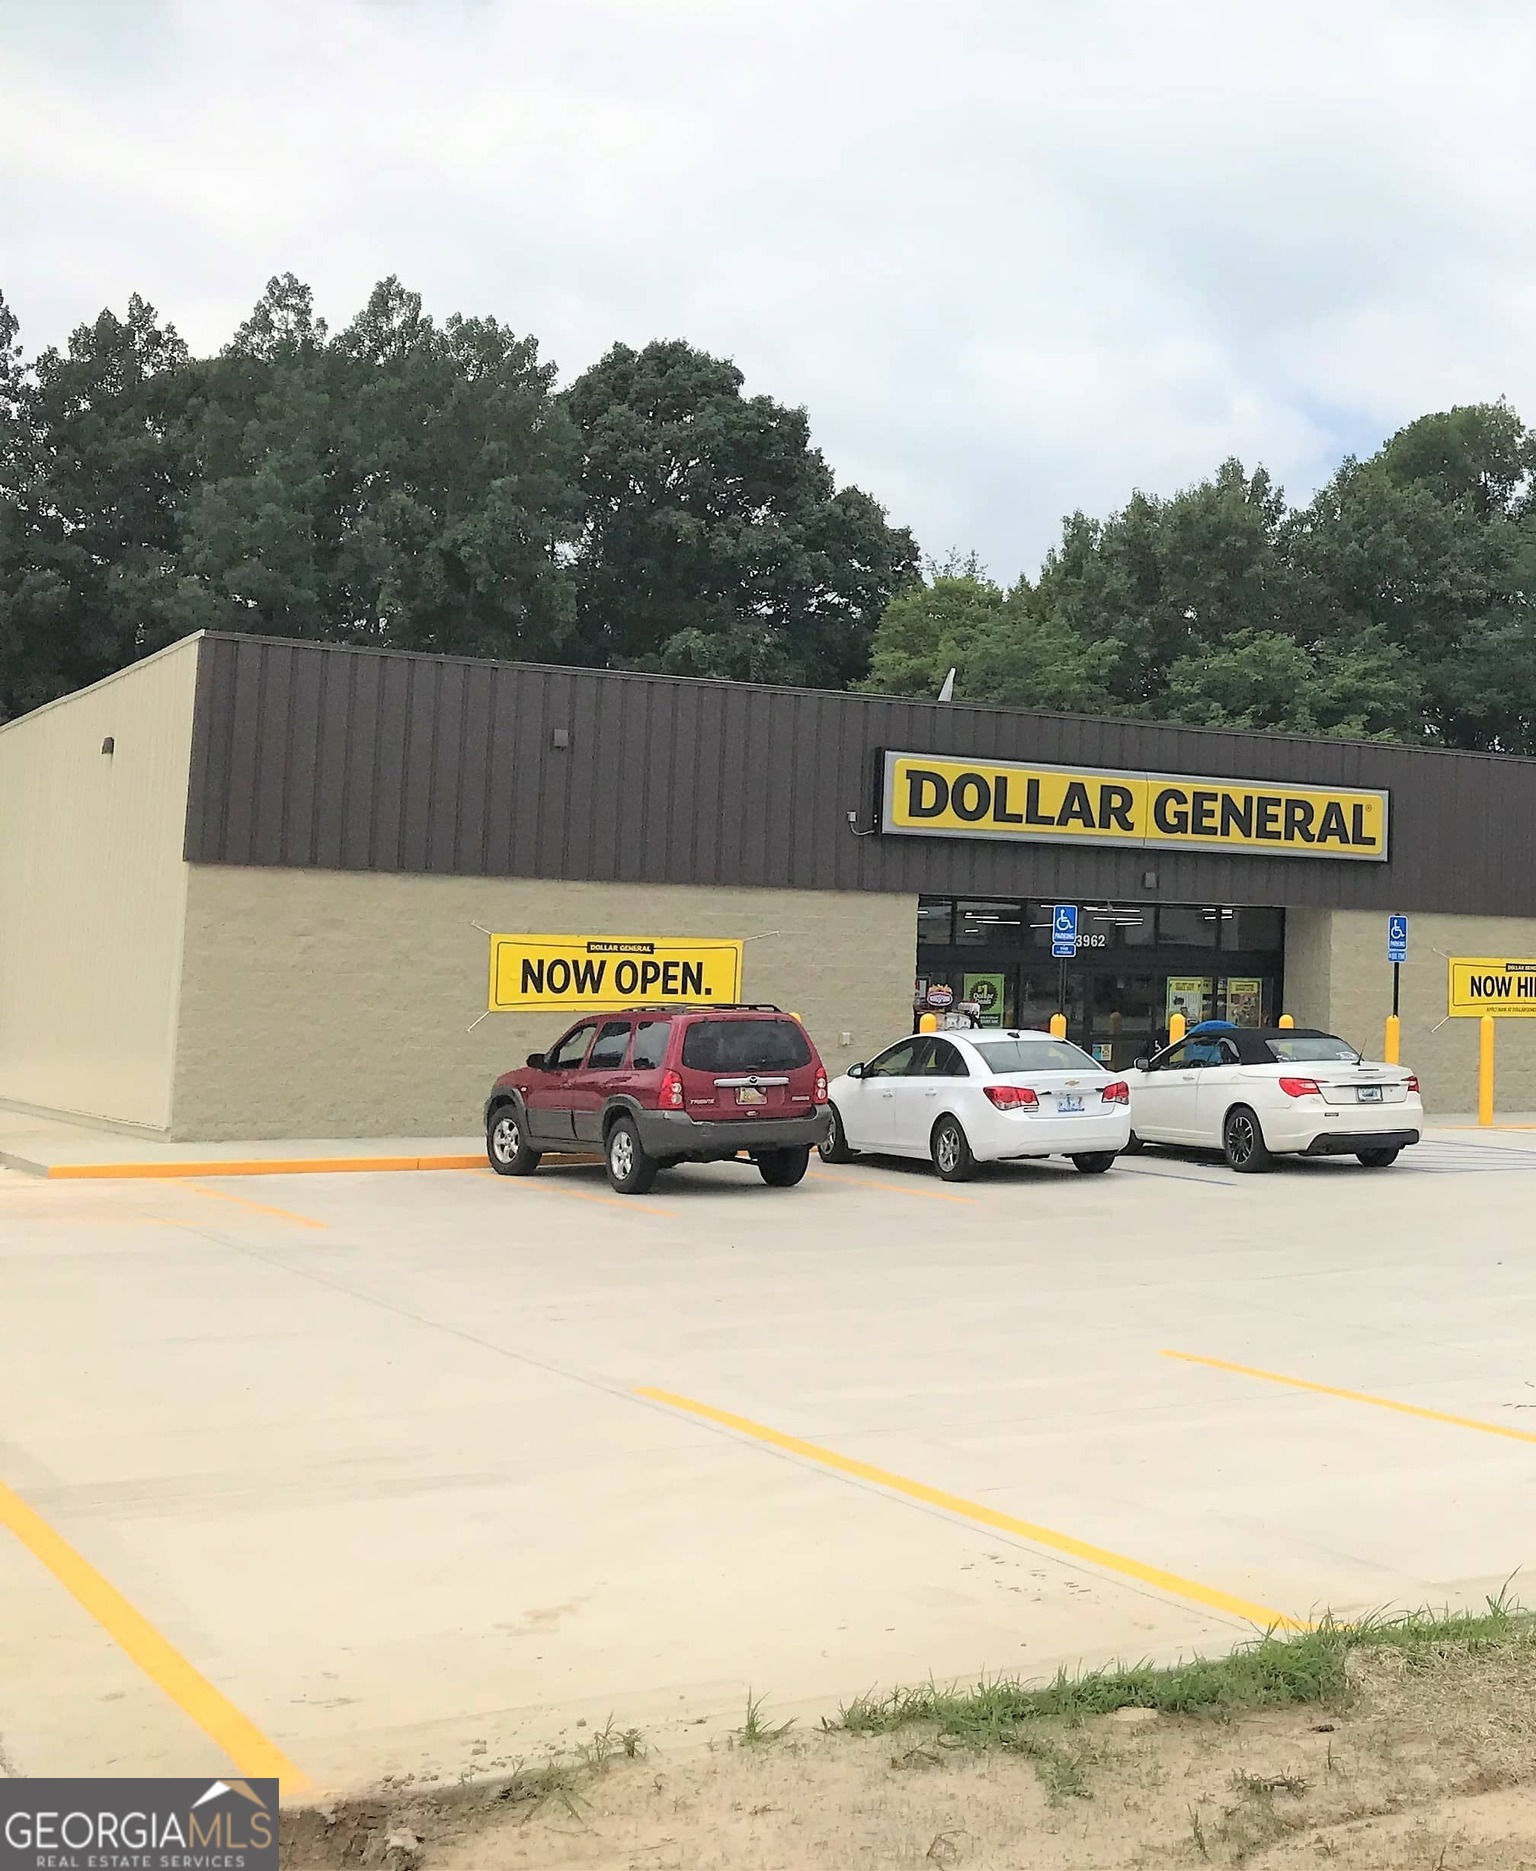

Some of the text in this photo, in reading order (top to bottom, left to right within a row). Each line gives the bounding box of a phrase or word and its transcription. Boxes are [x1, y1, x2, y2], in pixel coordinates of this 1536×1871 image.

[905, 768, 1377, 847] DOLLAR GENERAL
[590, 944, 652, 953] DOLLAR GENERAL
[1075, 934, 1106, 947] 3962
[521, 958, 713, 996] NOW OPEN.
[1470, 975, 1513, 998] NOW
